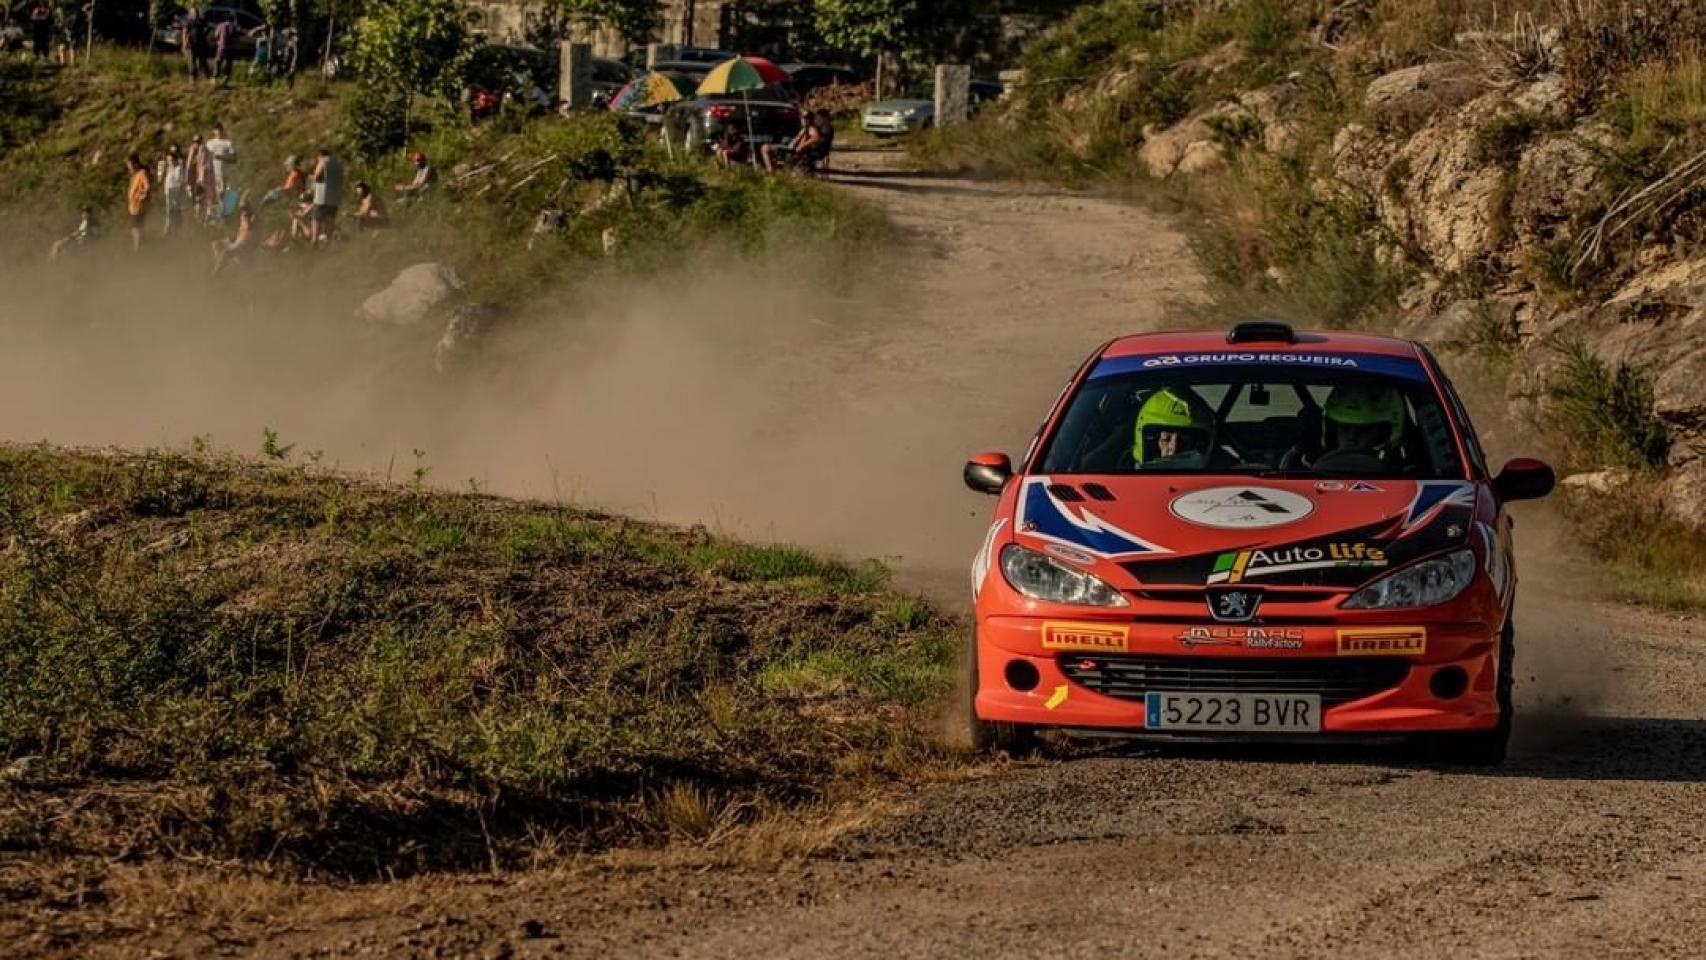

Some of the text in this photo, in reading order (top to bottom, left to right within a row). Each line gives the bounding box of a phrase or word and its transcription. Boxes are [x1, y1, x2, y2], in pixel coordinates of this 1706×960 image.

[1183, 353, 1255, 363] GRUPO
[1259, 354, 1358, 367] REGUEIRA
[1248, 546, 1323, 568] Auto
[1046, 626, 1125, 648] PIRELLI
[1341, 631, 1425, 651] PIRELLI
[1166, 697, 1310, 726] 5223 BVR
